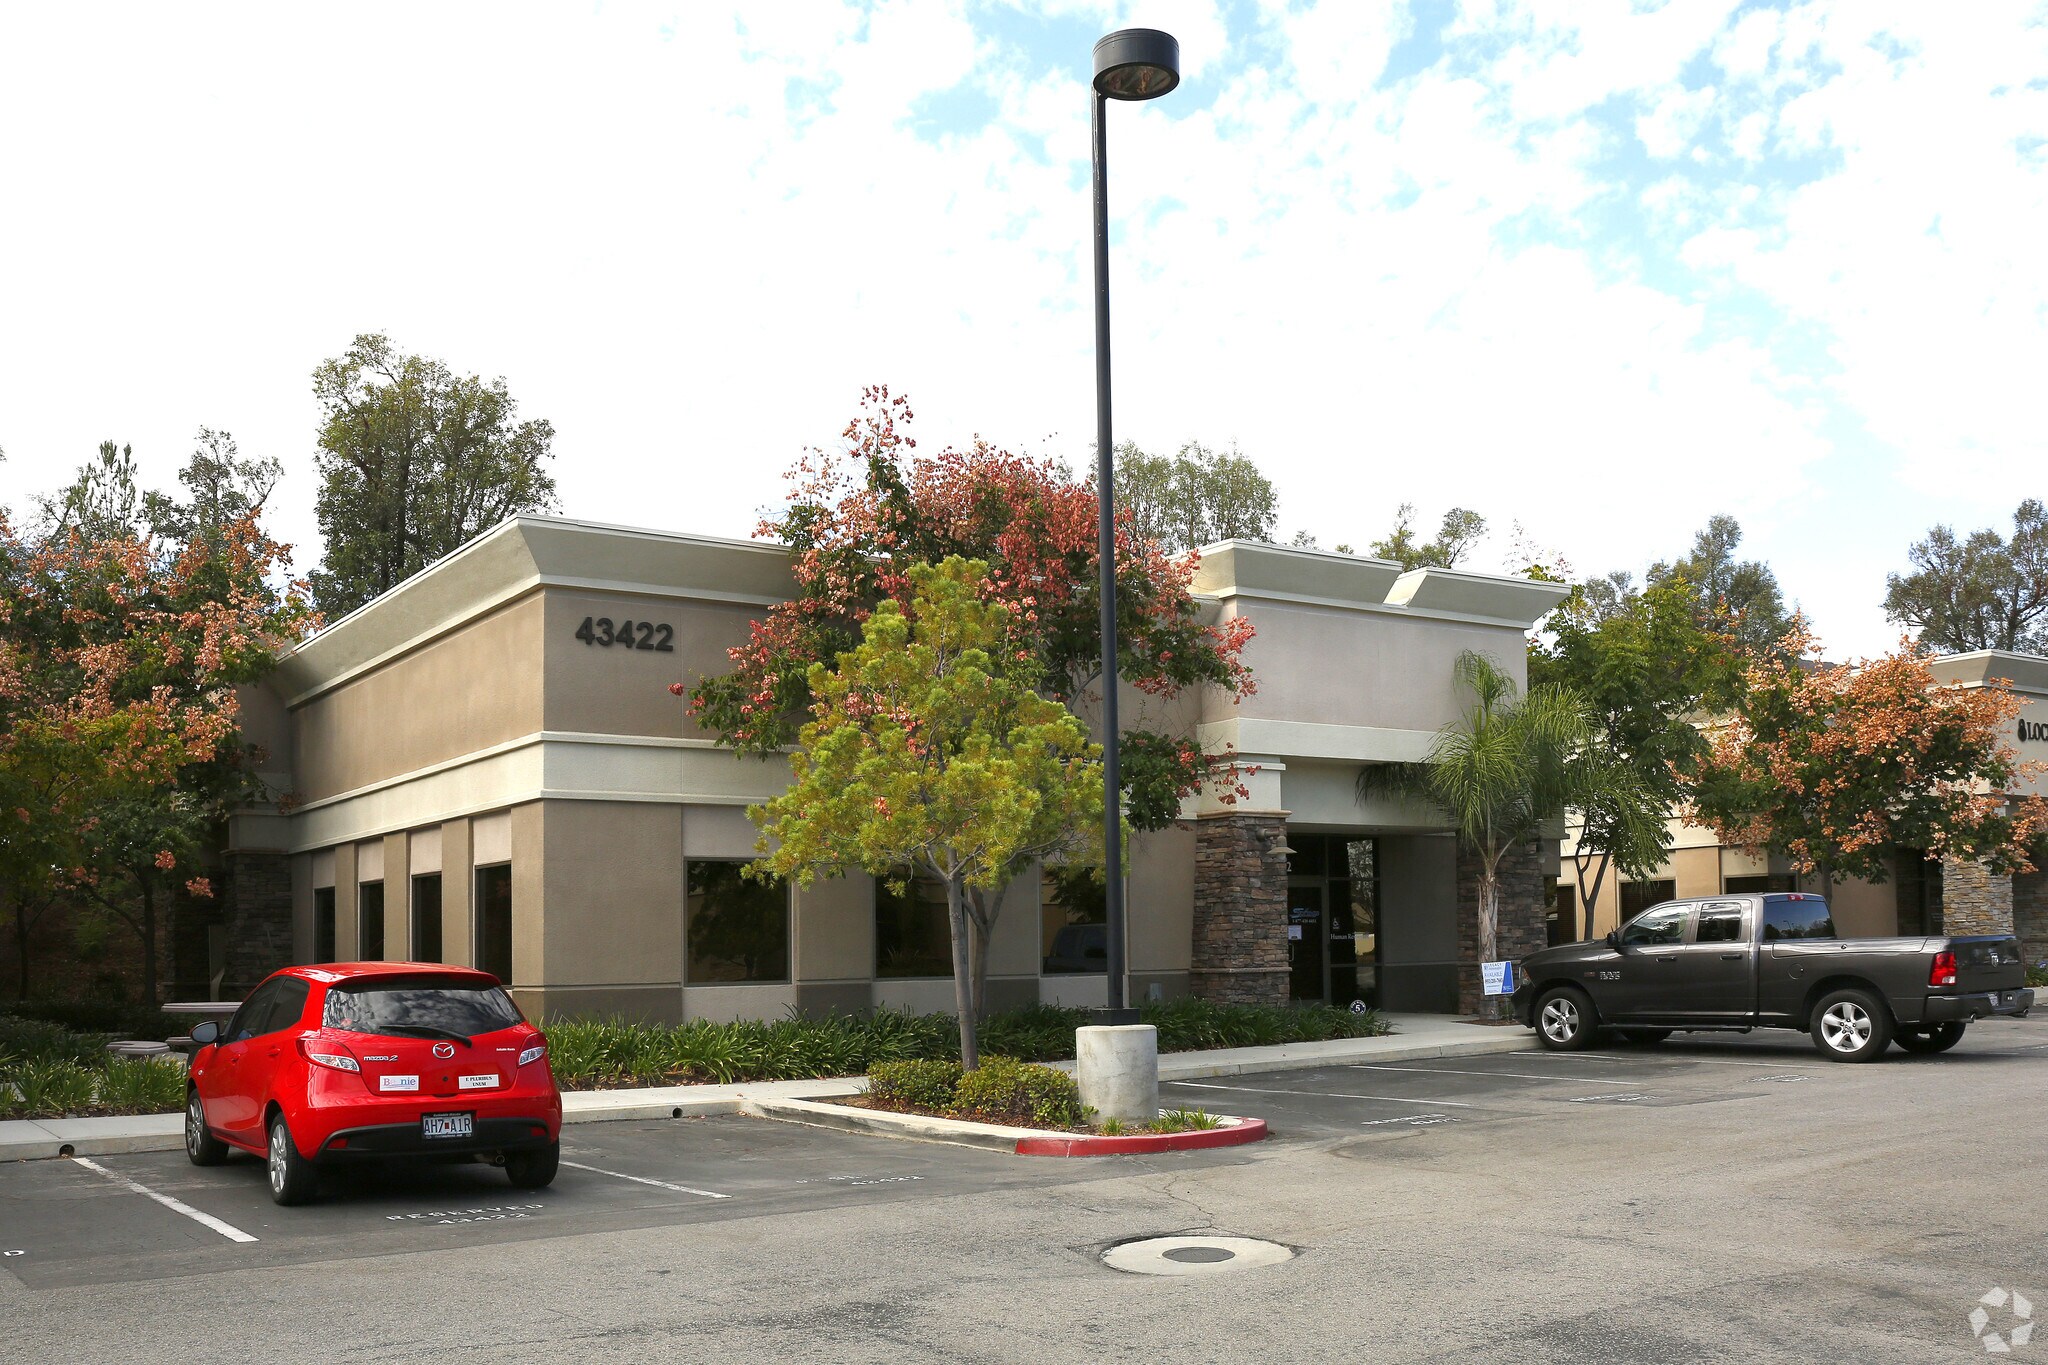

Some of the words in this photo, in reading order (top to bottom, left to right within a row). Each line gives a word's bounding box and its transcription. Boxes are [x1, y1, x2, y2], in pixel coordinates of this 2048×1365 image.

[575, 616, 674, 652] 43422
[383, 1077, 416, 1086] Bnie
[424, 1119, 444, 1134] AH7
[451, 1117, 471, 1132] A1R
